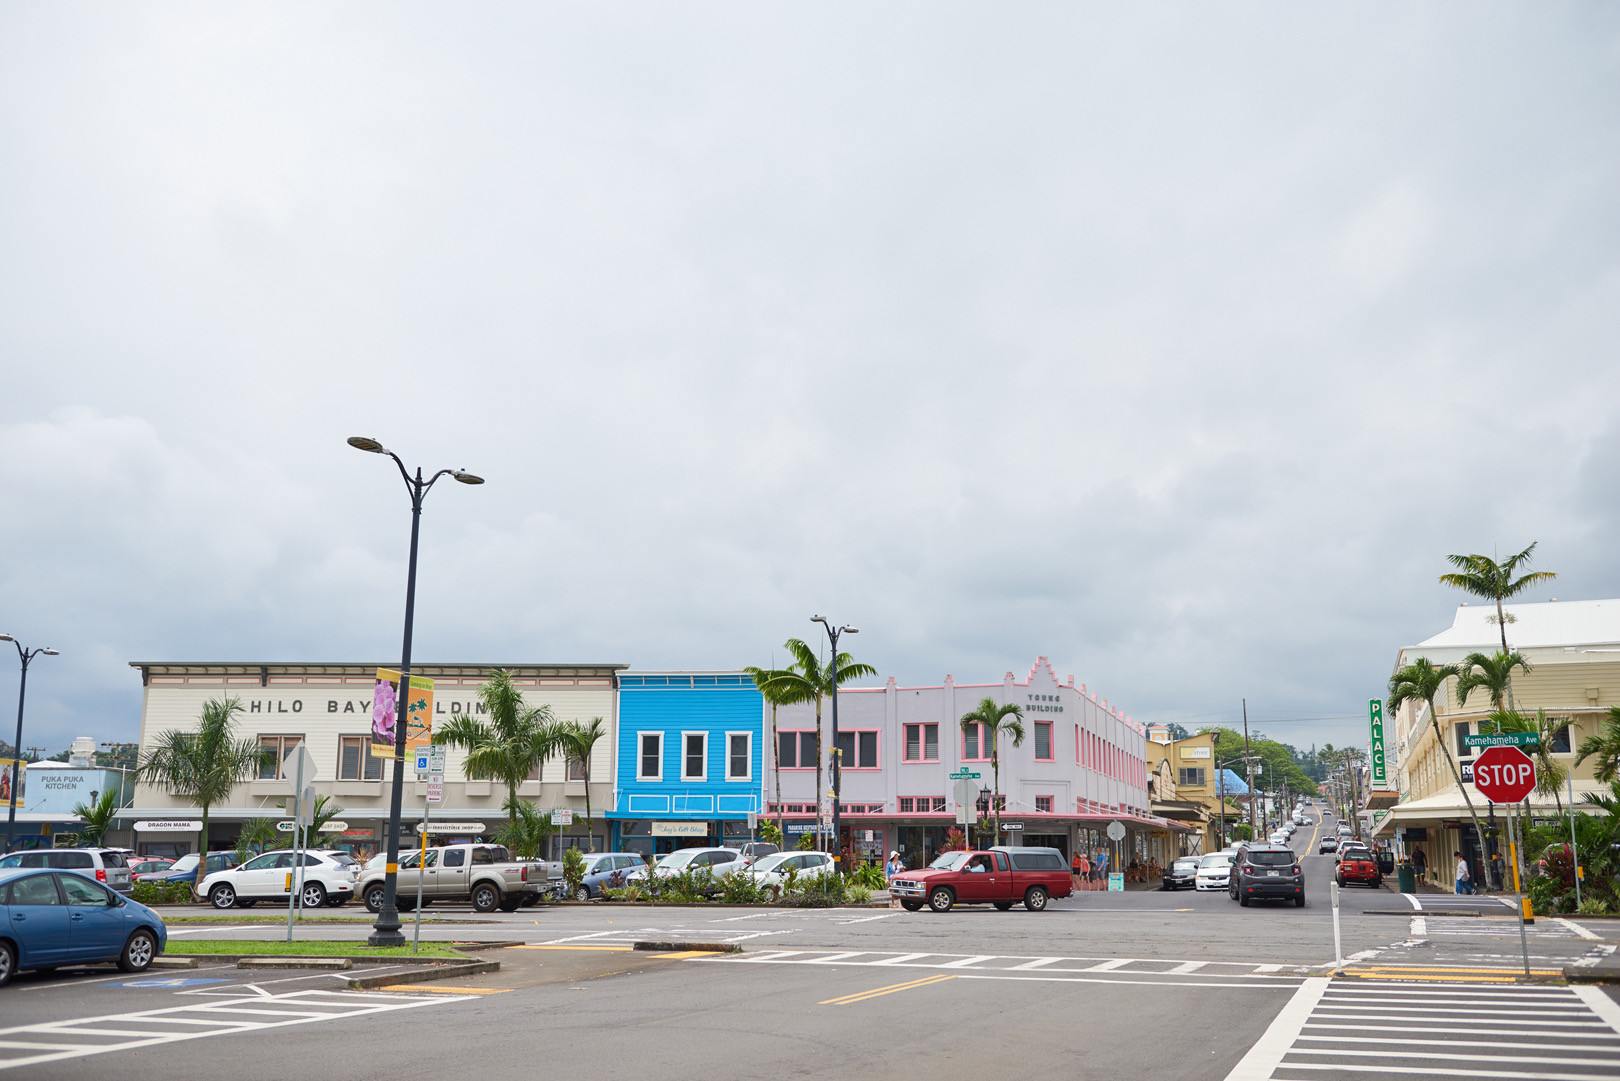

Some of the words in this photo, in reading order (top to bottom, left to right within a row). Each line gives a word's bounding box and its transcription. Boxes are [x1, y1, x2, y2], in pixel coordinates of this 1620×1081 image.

[1028, 694, 1060, 702] YOUNG
[250, 700, 303, 713] HILO
[327, 701, 371, 713] BAY
[1026, 704, 1064, 712] BUILDING
[1372, 703, 1383, 777] PALACE
[1464, 736, 1519, 746] Kamehameha
[1525, 736, 1537, 744] Ave
[1477, 763, 1531, 787] STOP
